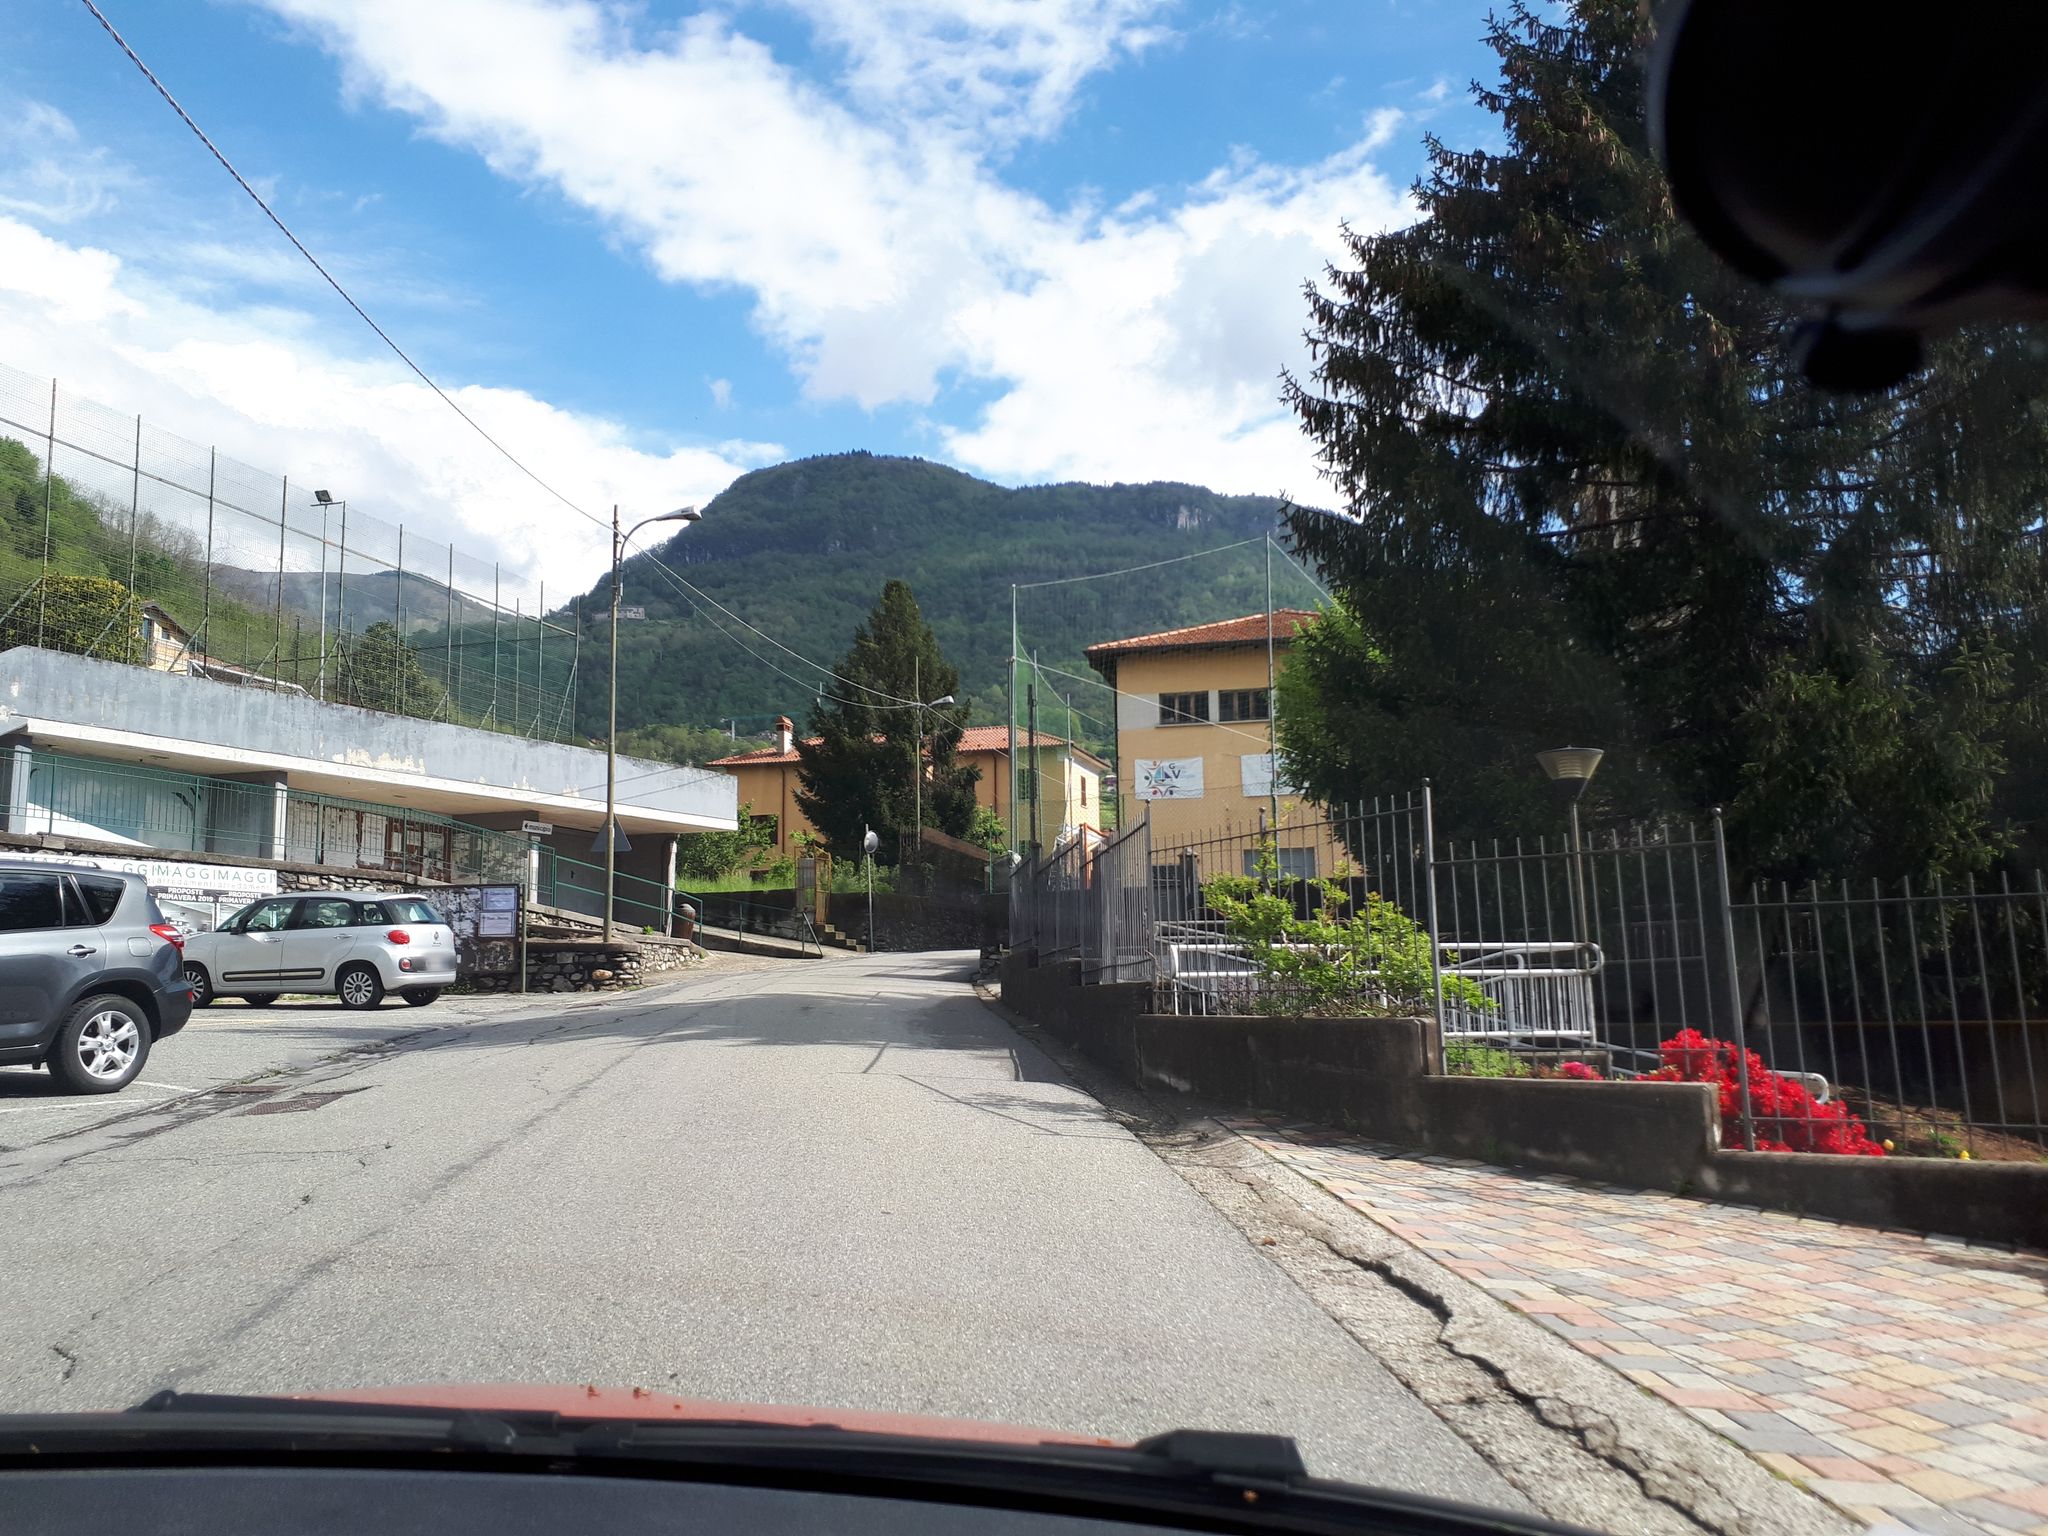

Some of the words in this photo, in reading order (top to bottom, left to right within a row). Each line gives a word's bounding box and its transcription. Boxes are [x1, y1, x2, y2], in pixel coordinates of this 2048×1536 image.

[1168, 762, 1176, 770] G
[1172, 769, 1181, 779] V
[168, 887, 204, 895] PROPOSTE
[229, 891, 262, 899] PROPOSTE
[157, 892, 196, 902] PRIMAVERA
[198, 895, 214, 903] 2019
[219, 896, 255, 904] PRIMAVERA
